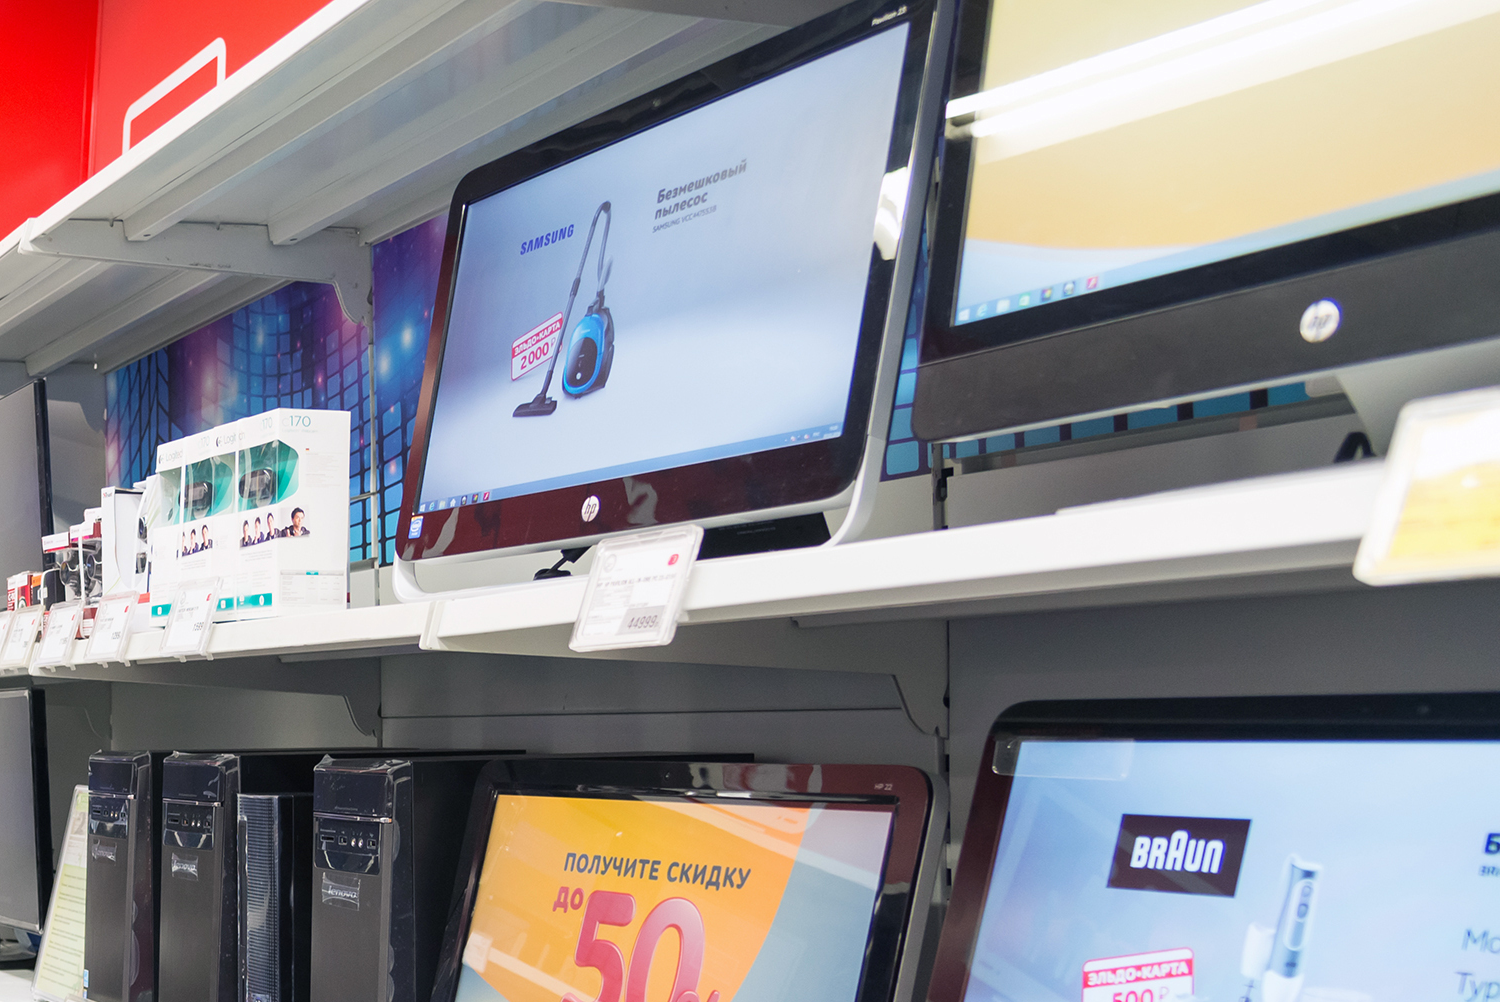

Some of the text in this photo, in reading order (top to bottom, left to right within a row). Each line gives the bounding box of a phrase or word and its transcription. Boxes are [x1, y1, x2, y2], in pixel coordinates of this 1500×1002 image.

[656, 158, 747, 204] Безмешковый
[654, 192, 708, 220] пылесос
[652, 217, 681, 234] SAMSUNG
[520, 224, 575, 256] SAMSUNG
[223, 431, 245, 446] Logitch
[582, 495, 600, 522] hp
[1129, 829, 1225, 875] BRAUN
[563, 851, 752, 891] ПОЛУЧИТЕ СКИДКУ
[327, 884, 358, 899] lenovo
